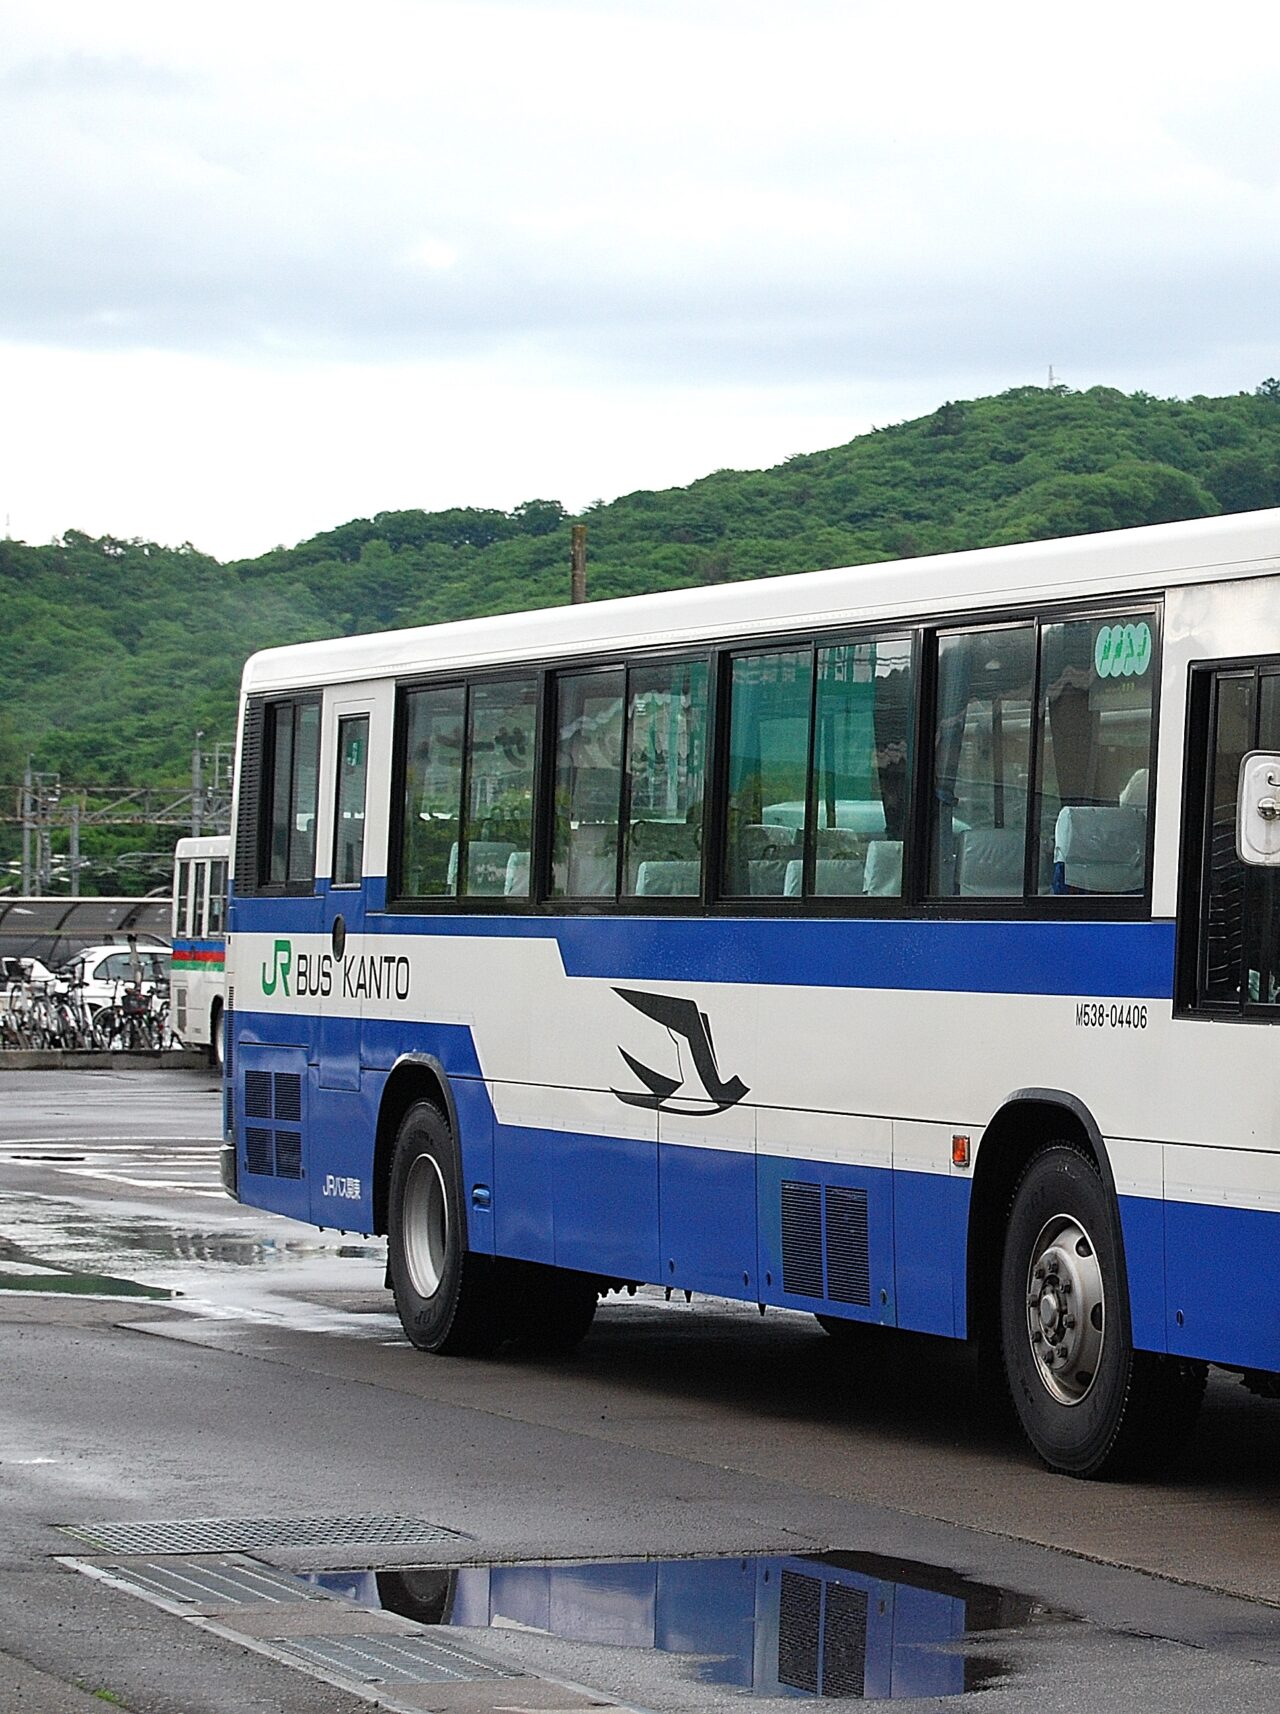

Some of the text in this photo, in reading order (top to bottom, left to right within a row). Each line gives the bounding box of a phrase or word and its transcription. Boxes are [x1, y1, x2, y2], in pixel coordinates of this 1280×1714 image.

[261, 939, 410, 1000] JR BUS KANTO
[1075, 1003, 1148, 1029] M538-04406
